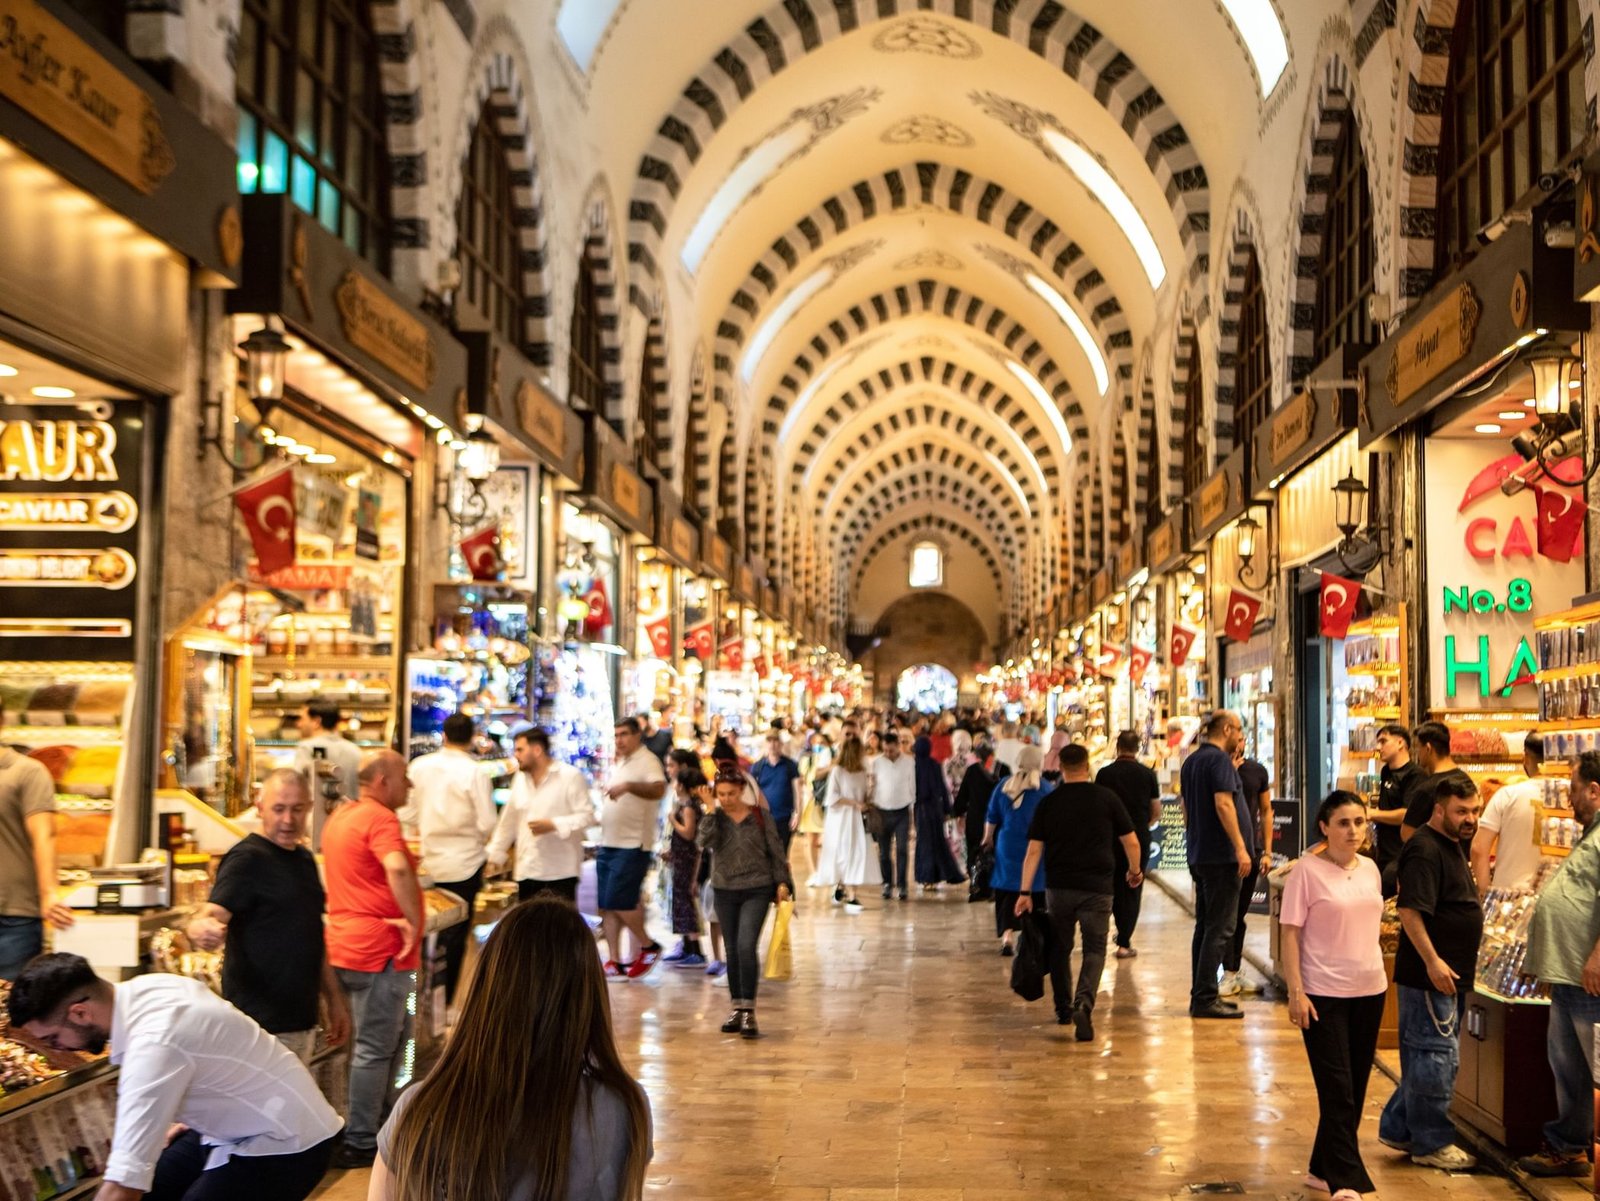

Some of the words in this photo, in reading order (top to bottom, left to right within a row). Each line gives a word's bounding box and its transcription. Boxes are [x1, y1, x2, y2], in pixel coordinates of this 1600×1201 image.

[1515, 288, 1521, 313] 8
[0, 420, 119, 481] AUR
[1443, 577, 1533, 614] No.8
